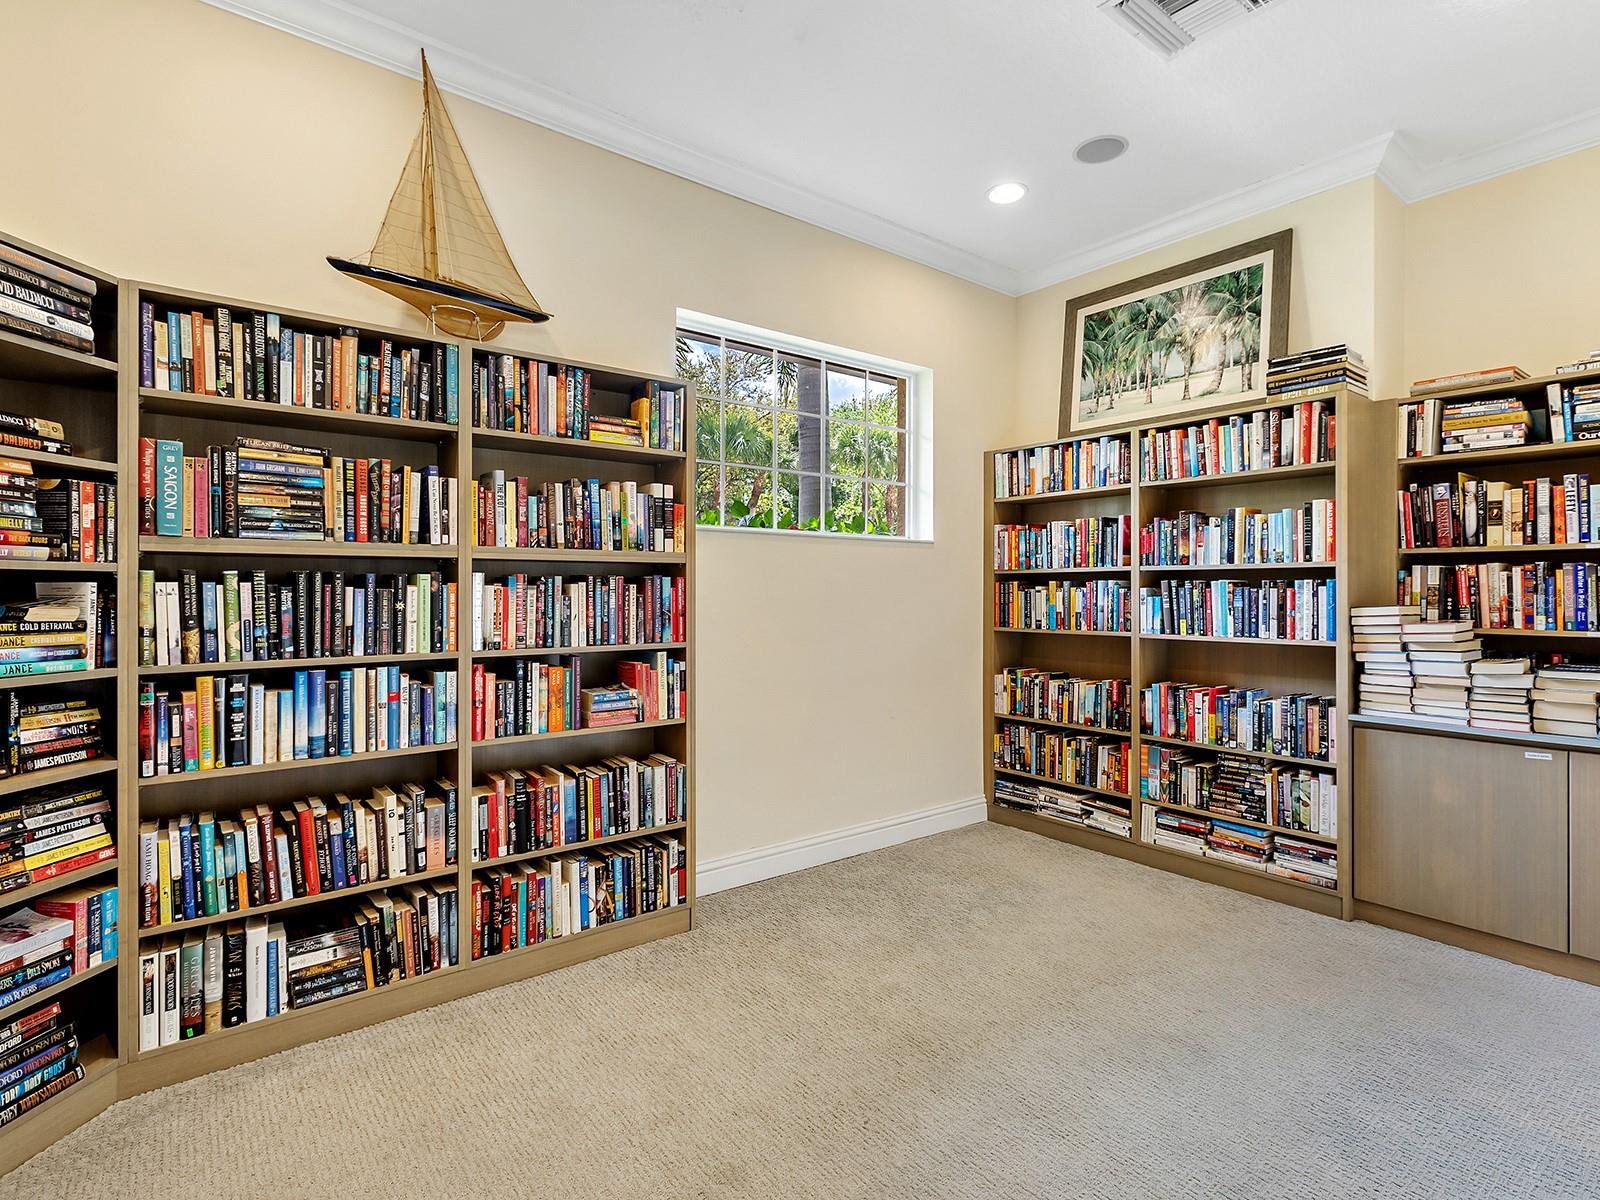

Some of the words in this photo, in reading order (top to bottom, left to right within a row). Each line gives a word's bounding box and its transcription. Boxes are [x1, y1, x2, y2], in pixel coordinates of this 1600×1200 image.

[8, 268, 39, 286] BALDACCI
[49, 286, 81, 303] COLLECTORS
[15, 286, 55, 310] BALDACCI
[218, 308, 230, 332] ELIZABETH
[254, 316, 264, 328] TESS
[218, 332, 230, 352] GEORGE
[254, 328, 264, 358] GERRITSEN
[256, 362, 264, 371] THE
[256, 370, 264, 392] SINNER
[4, 434, 42, 450] BALDACCI
[266, 464, 286, 472] GRISHAM
[346, 470, 354, 480] WAY
[164, 465, 178, 509] SAIGON
[346, 480, 354, 492] BACK
[225, 480, 234, 523] DAKOTA
[346, 494, 354, 516] ANDREW
[1566, 490, 1576, 512] LEFTY
[346, 516, 354, 532] GROSS
[1440, 501, 1450, 537] EINSTEIN
[1540, 514, 1548, 538] HUGHES
[254, 573, 265, 598] PACIFIC
[254, 600, 265, 626] HEIGHTS
[20, 622, 39, 631] COLD
[41, 622, 74, 630] BETRAYAL
[3, 664, 33, 676] JANCE
[200, 680, 211, 696] CARL
[200, 696, 211, 725] HIAASEN
[67, 724, 89, 736] NOISE
[34, 758, 54, 770] JAMES
[54, 750, 88, 766] PATTERSON
[388, 808, 396, 819] IQ
[34, 827, 56, 839] JAMES
[56, 817, 91, 833] PATTERSON
[448, 828, 456, 838] NO
[98, 848, 116, 860] GONE
[144, 838, 152, 858] TAMI
[144, 860, 152, 880] HOAG
[208, 947, 216, 962] JOHN
[228, 935, 242, 963] SUSAN
[190, 956, 200, 988] GREG
[190, 992, 200, 1018] ILES
[228, 983, 242, 1011] ISAACS
[50, 1029, 66, 1042] PREY
[43, 1058, 66, 1080] GHOST
[20, 1090, 40, 1112] JOHN
